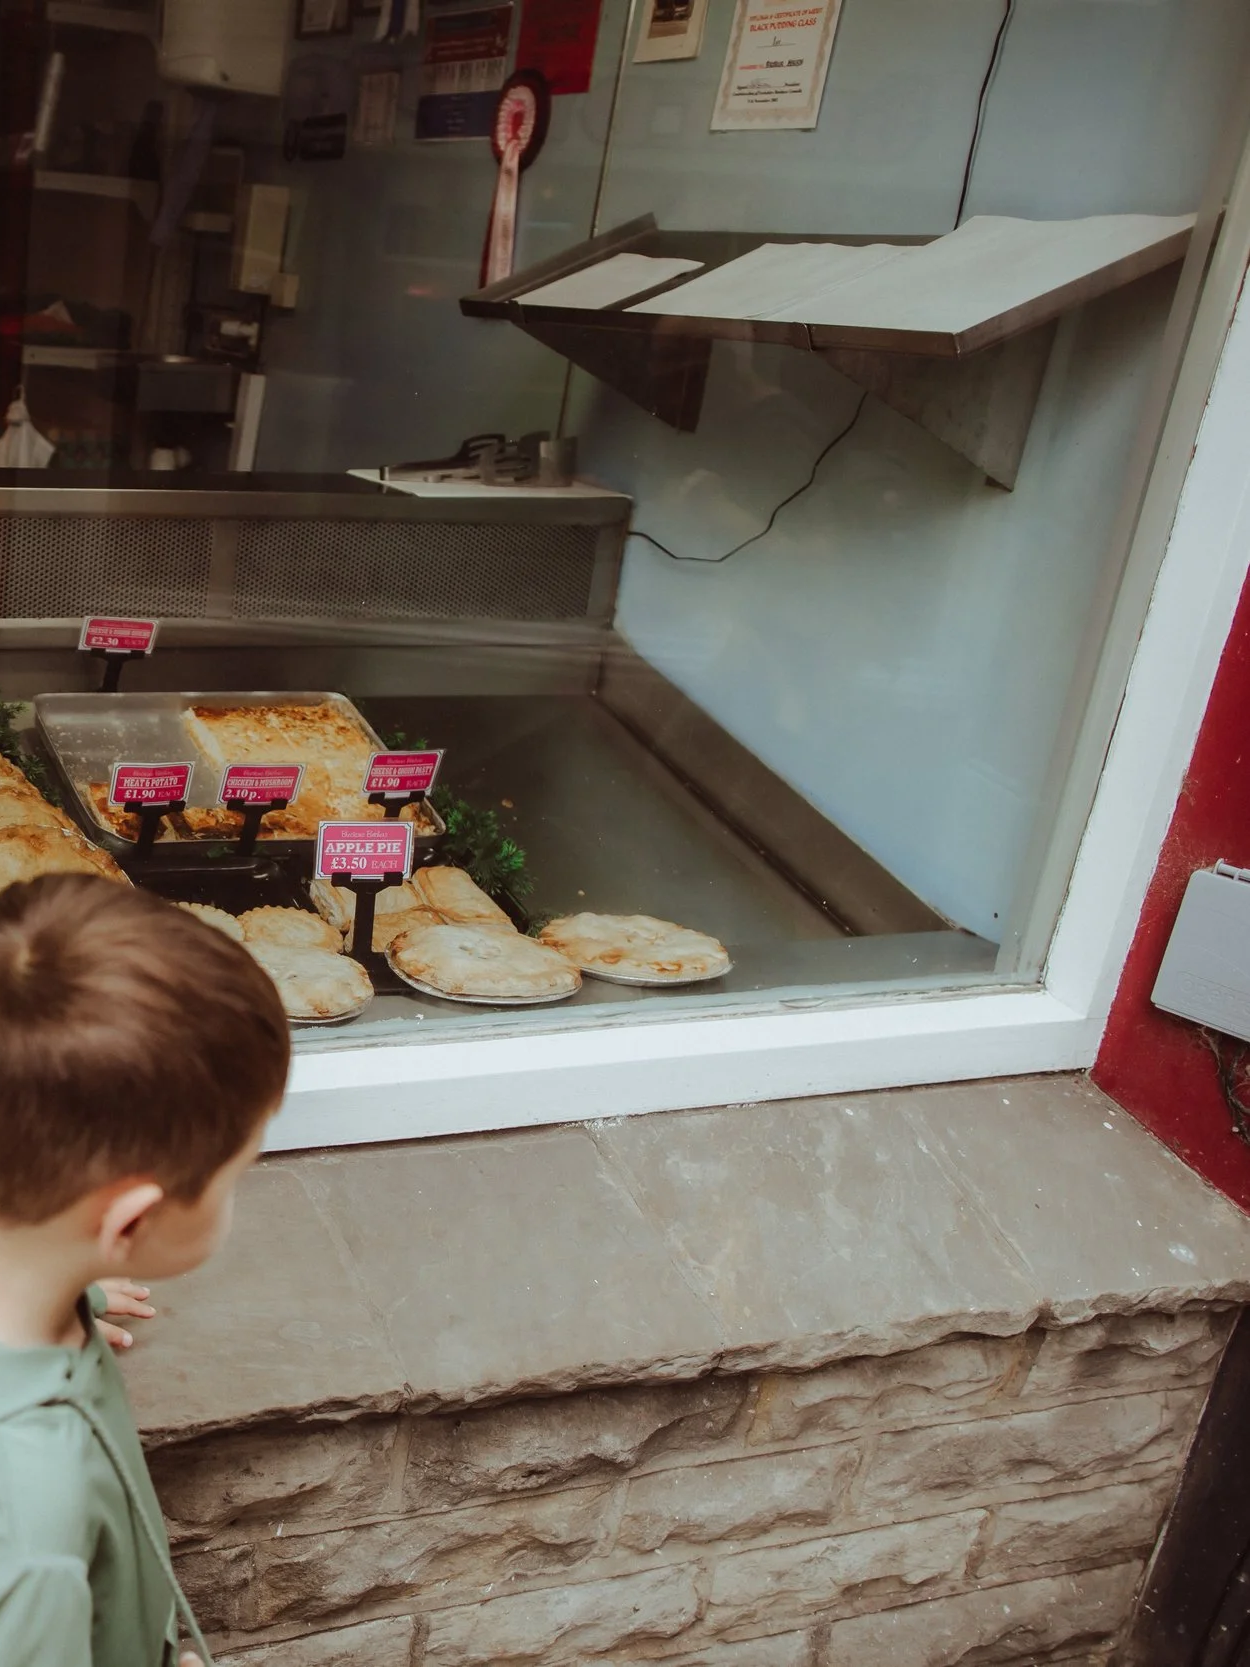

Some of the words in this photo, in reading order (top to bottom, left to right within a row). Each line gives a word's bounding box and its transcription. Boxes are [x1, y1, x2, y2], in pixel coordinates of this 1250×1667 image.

[750, 23, 769, 32] BLACK
[770, 20, 797, 30] PUDDING
[798, 17, 817, 27] CLASS
[90, 636, 119, 646] £2.30
[371, 767, 393, 776] CHEESE
[415, 765, 434, 775] PASTY
[123, 778, 146, 787] MEAT
[151, 777, 178, 787] POTATO
[227, 778, 255, 787] CHICKEN
[259, 778, 294, 787] MUSHROOM
[370, 777, 400, 788] £1.90
[124, 789, 156, 799] £1.90
[324, 842, 374, 853] APPLE
[376, 842, 401, 853] PIE
[330, 856, 367, 870] £3.50
[371, 860, 398, 869] EACH
